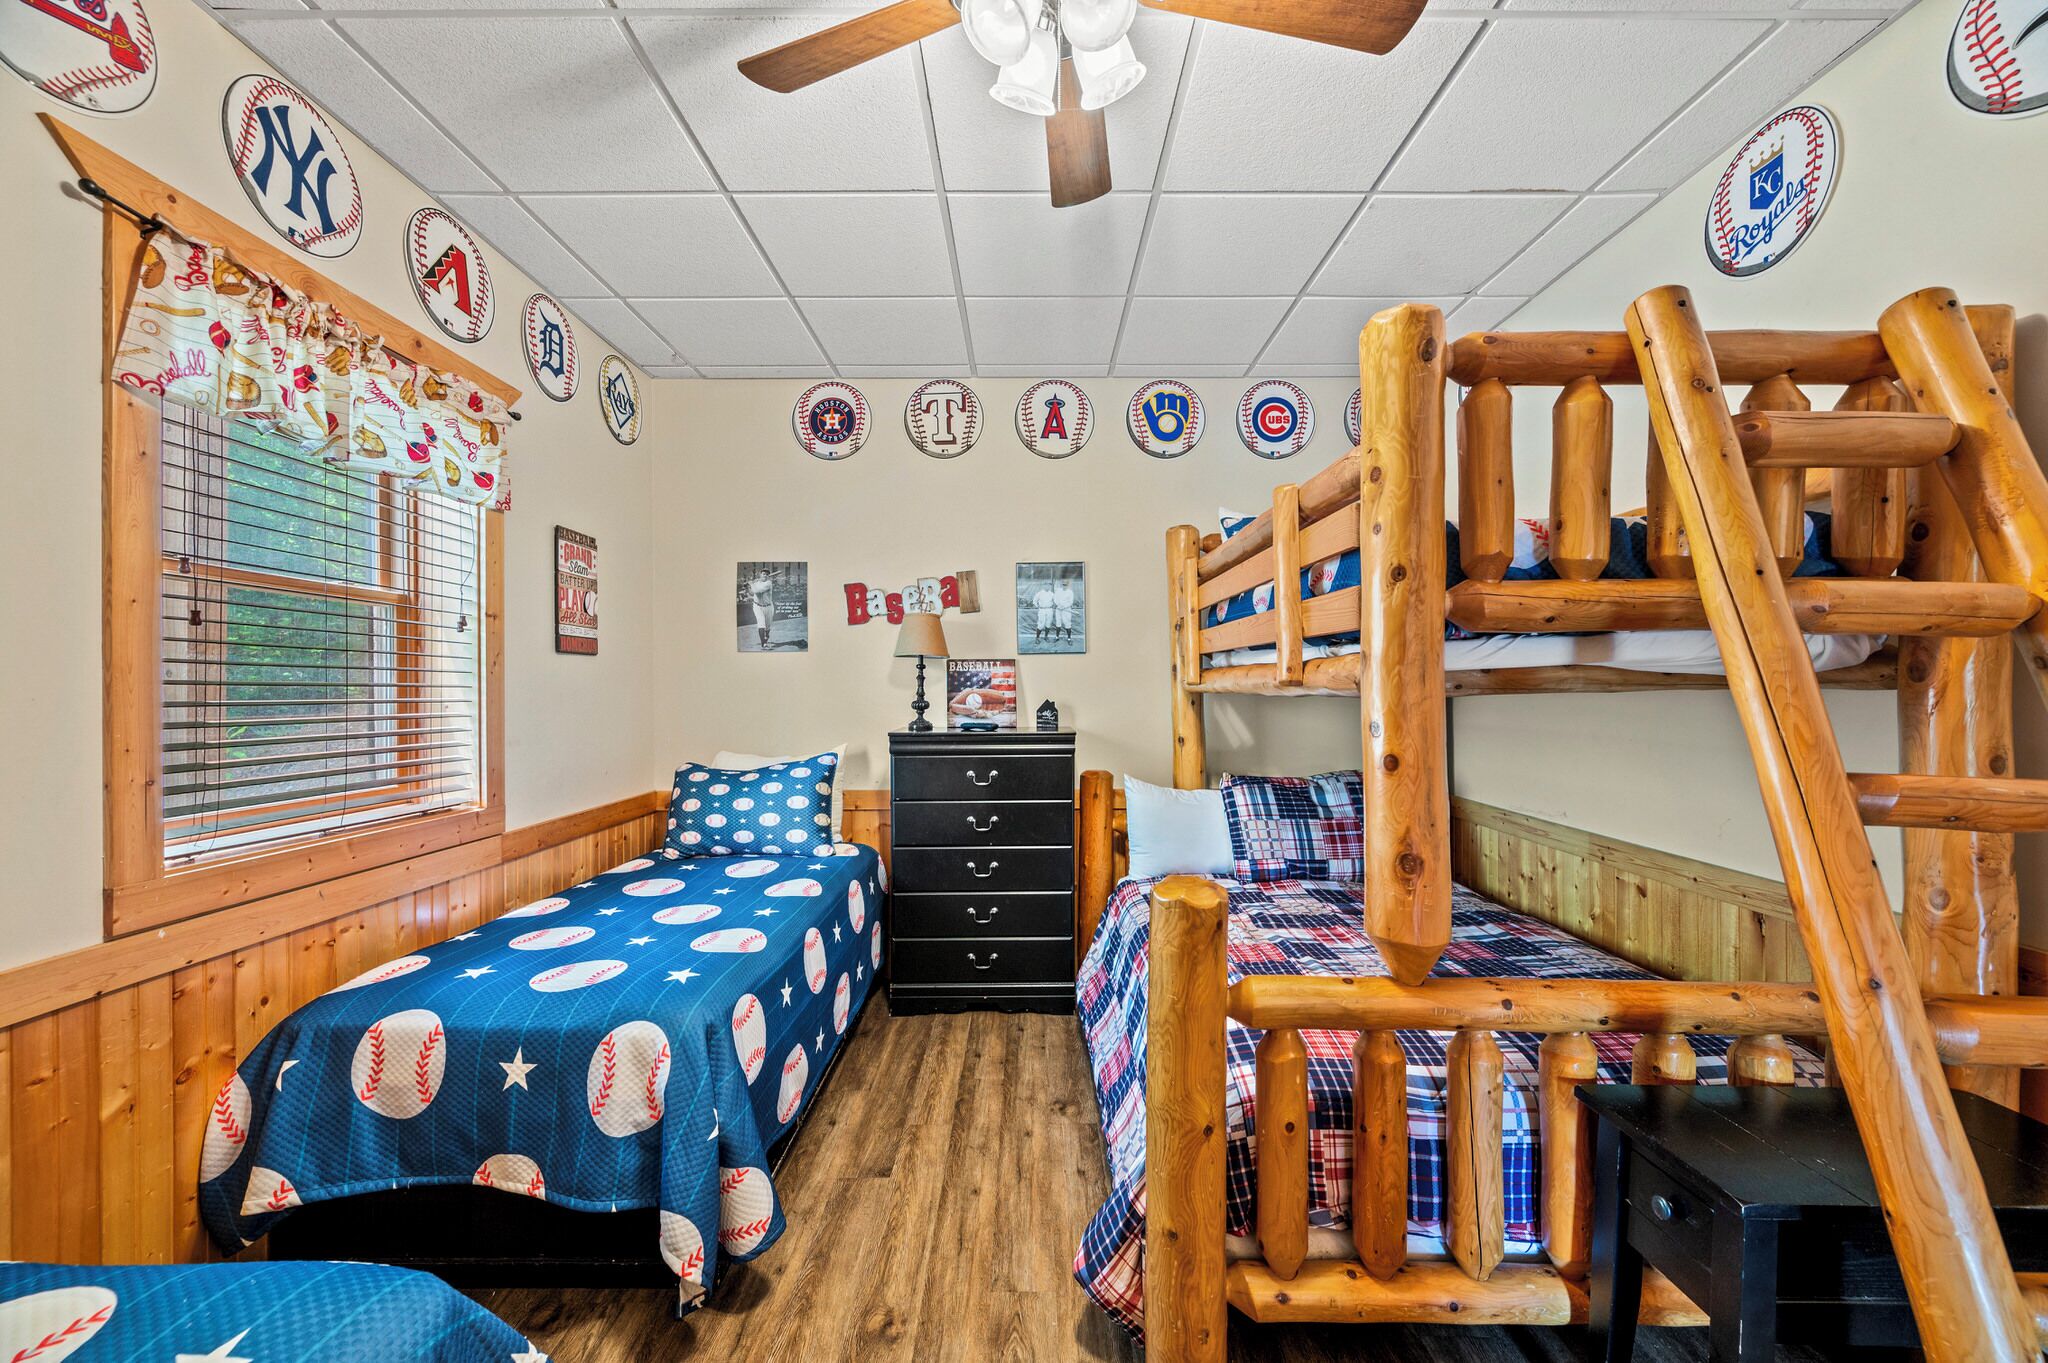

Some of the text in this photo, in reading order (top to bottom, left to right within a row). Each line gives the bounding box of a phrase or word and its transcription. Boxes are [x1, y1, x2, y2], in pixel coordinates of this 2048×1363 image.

[1752, 166, 1783, 201] KC
[1729, 176, 1808, 261] Royals
[814, 399, 850, 415] HOUSTON
[824, 413, 842, 431] H
[920, 392, 967, 445] T
[1040, 398, 1069, 440] A
[816, 430, 850, 443] ASTROS
[564, 543, 593, 570] GRAND
[568, 560, 590, 577] Slam
[560, 573, 586, 588] BATTER
[559, 586, 585, 612] PLAY
[560, 610, 577, 623] All
[949, 660, 1001, 672] BASEBALL
